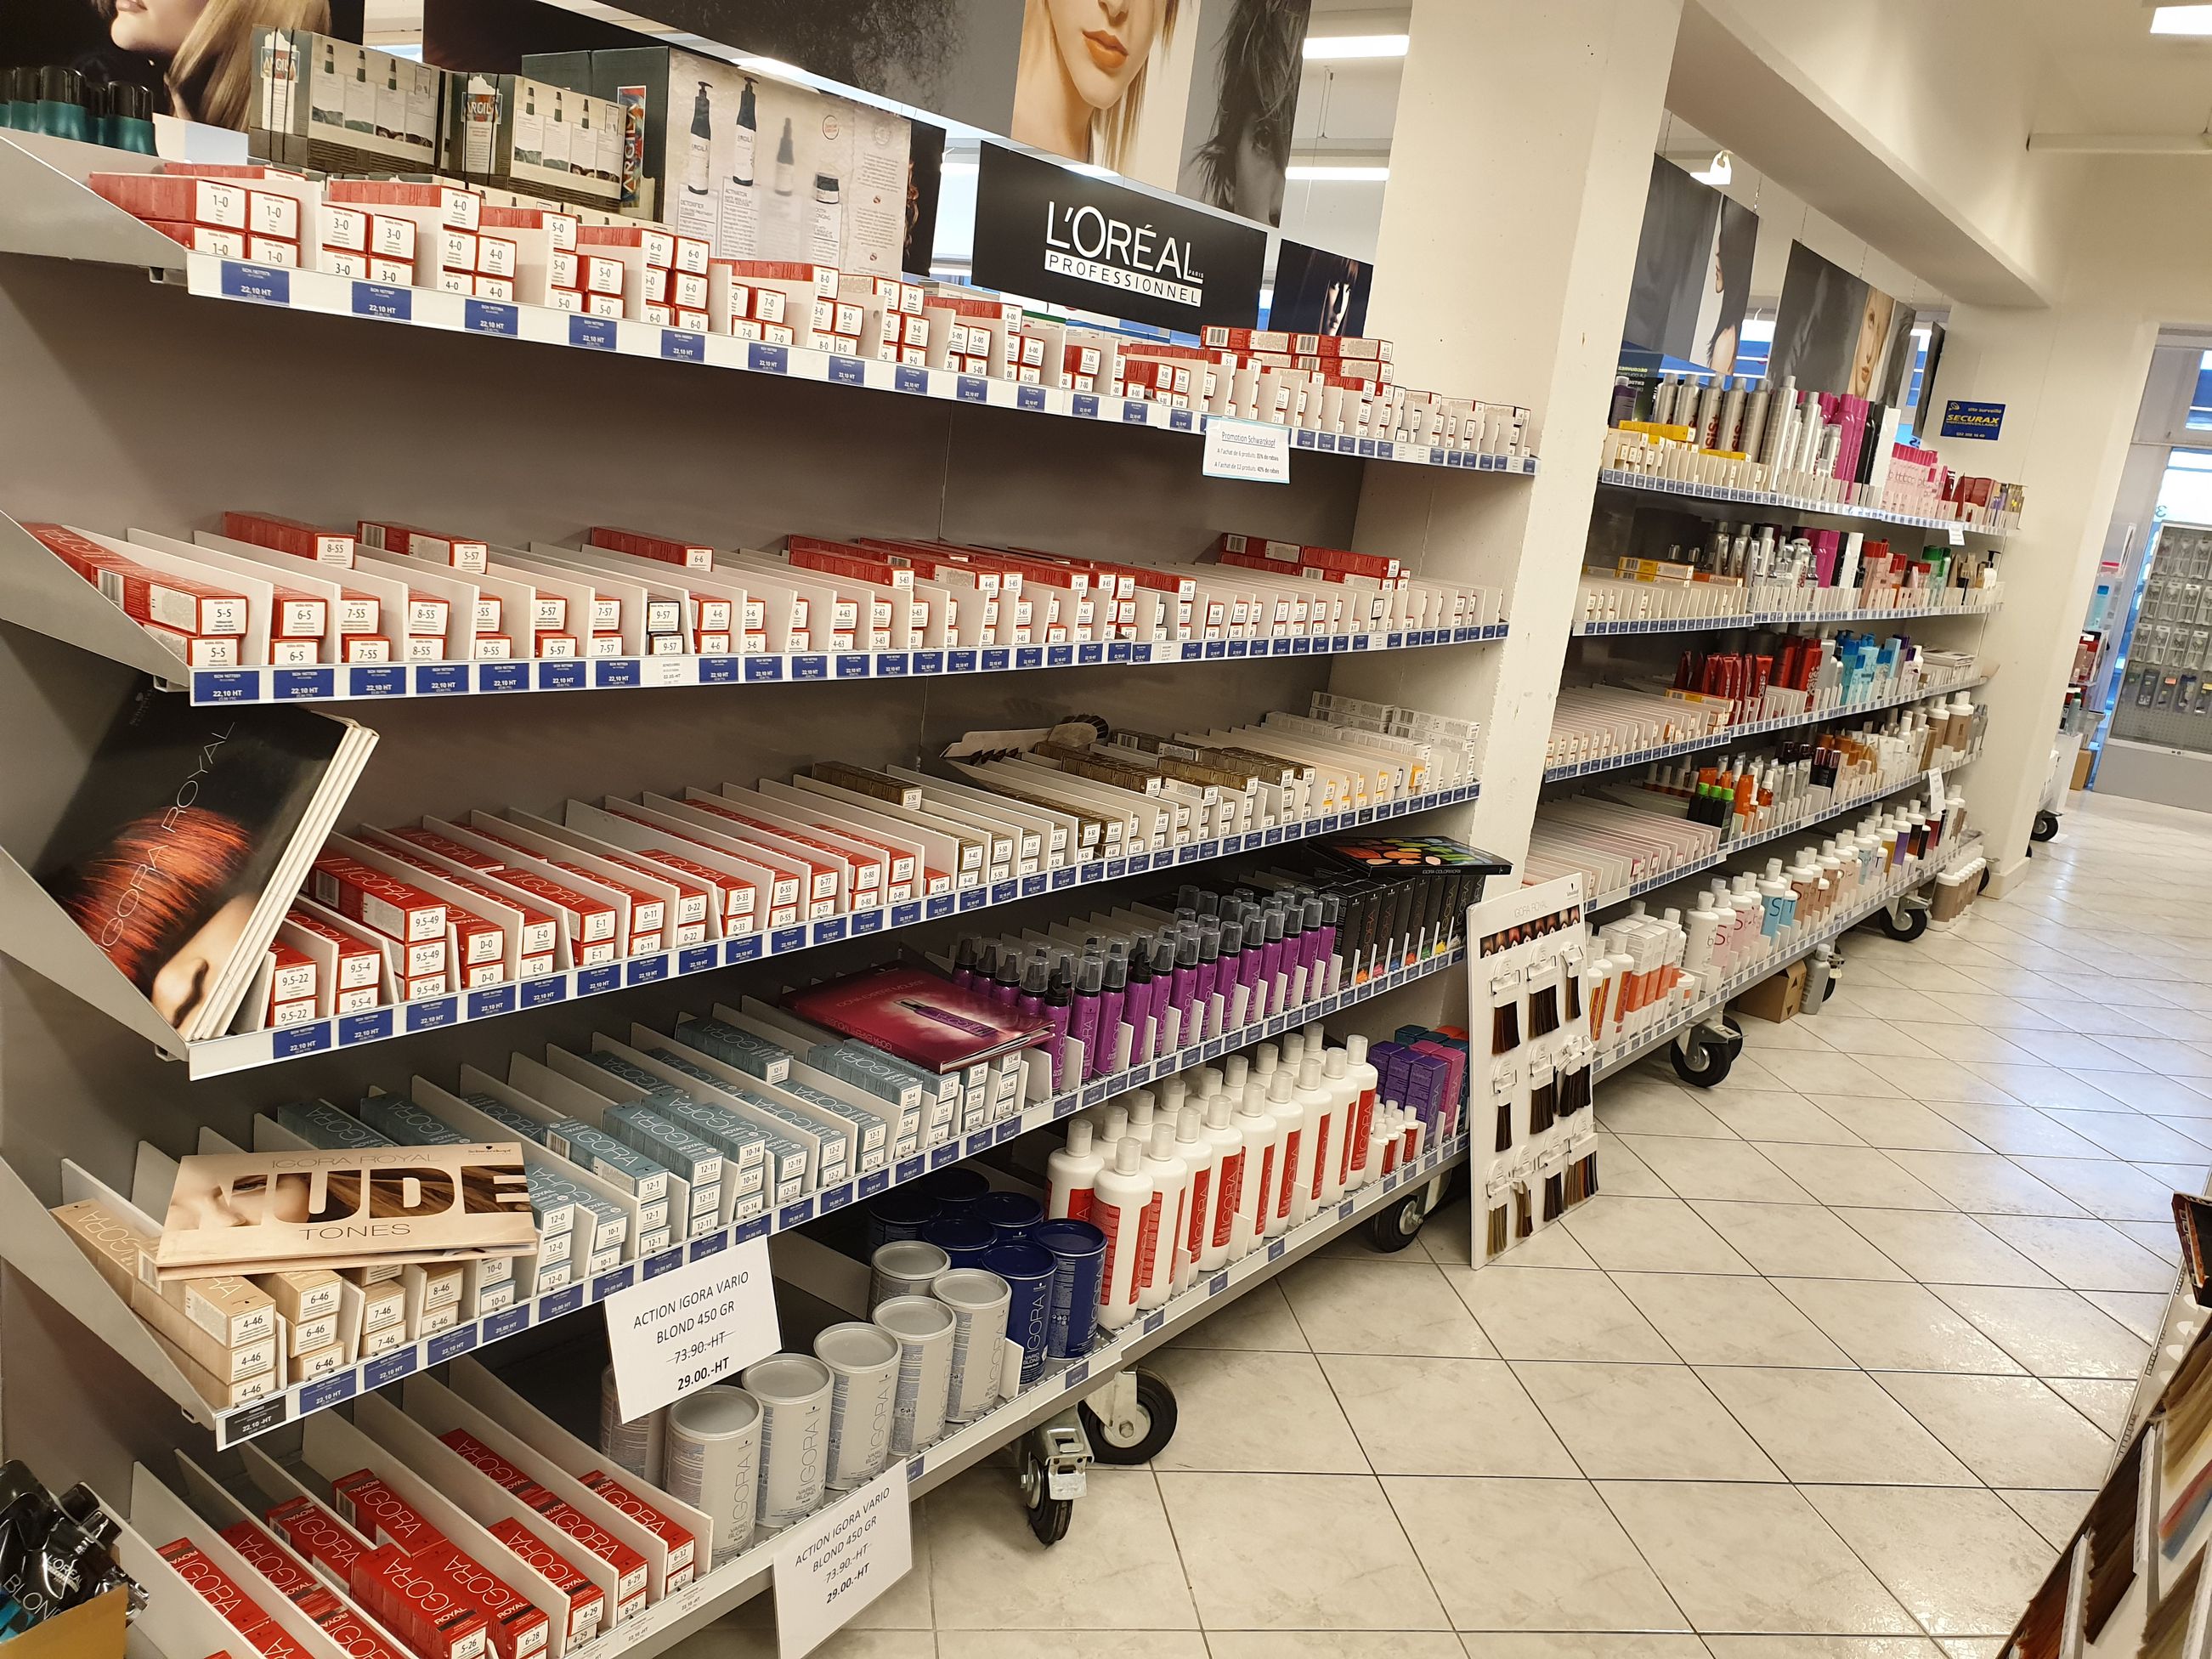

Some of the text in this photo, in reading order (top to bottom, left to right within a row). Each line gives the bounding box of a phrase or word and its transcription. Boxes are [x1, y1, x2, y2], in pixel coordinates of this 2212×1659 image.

[213, 195, 228, 207] 1-0
[454, 200, 467, 211] 4-0
[267, 205, 280, 218] 1-0
[334, 218, 348, 230] 3-0
[387, 229, 400, 240] 3-0
[651, 242, 661, 252] 6-0
[1046, 201, 1203, 284] L'ORÉAL
[490, 249, 502, 259] 4-0
[688, 249, 699, 258] 6-0
[600, 267, 611, 277] 5-0
[1188, 269, 1204, 278] PARIS
[1049, 255, 1198, 304] PROFESSIONNEL
[1946, 415, 2000, 423] SECURAX
[1222, 431, 1247, 441] Promotion
[326, 544, 343, 553] 8-55
[464, 552, 478, 560] 5-57
[217, 609, 231, 618] 5-5
[297, 610, 311, 620] 6-5
[348, 609, 365, 618] 7-55
[417, 609, 435, 619] 8-55
[540, 607, 556, 615] 5-57
[598, 608, 613, 616] 7-57
[484, 646, 499, 654] 9-55
[97, 722, 235, 953] IGORA ROYAL
[348, 870, 415, 901] IGORA
[521, 878, 586, 905] IGORA
[780, 886, 791, 894] 0-55
[737, 893, 749, 902] 0-33
[687, 903, 700, 911] 0-22
[644, 910, 657, 919] 0-11
[537, 930, 547, 938] E-0
[481, 940, 492, 949] D-0
[1083, 1020, 1095, 1061] IGORA
[833, 1049, 889, 1078] IGORA
[1446, 1079, 1459, 1115] IGORA
[1428, 1083, 1440, 1130] IGORA
[630, 1109, 687, 1147] IGORA
[1361, 1103, 1375, 1155] IGORA
[574, 1129, 642, 1168] IGORA
[272, 1154, 440, 1168] IGORA ROYAL
[701, 1162, 716, 1174] 12-11
[647, 1181, 659, 1190] 12-1
[1222, 1170, 1239, 1241] IGORA
[551, 1214, 565, 1224] 12-0
[299, 1224, 410, 1240] TONES
[608, 1226, 619, 1236] 10-1
[487, 1263, 502, 1273] 10-0
[433, 1283, 450, 1294] 8-46
[311, 1292, 329, 1303] 6-46
[634, 1271, 749, 1328] ACTION IGORA VARIO
[375, 1306, 392, 1317] 7-46
[243, 1315, 263, 1328] 4-46
[657, 1301, 734, 1344] BLOND 450 GR
[1027, 1294, 1045, 1354] IGORA
[674, 1332, 726, 1364] 73.90.-HT
[1023, 1356, 1039, 1365] BLOND
[677, 1357, 729, 1390] 29.00.-HT
[870, 1387, 889, 1453] IGORA
[801, 1418, 819, 1486] IGORA
[455, 1441, 516, 1486] IGORA
[733, 1453, 751, 1523] IGORA
[284, 1508, 315, 1522] ROYAL
[360, 1487, 421, 1537] IGORA
[602, 1486, 665, 1535] IGORA
[795, 1487, 890, 1566] ACTION IGORA VARIO
[298, 1515, 360, 1568] IGORA
[552, 1510, 619, 1560] IGORA
[812, 1516, 877, 1572] BLOND 450 GR
[508, 1531, 581, 1589] IGORA
[674, 1549, 687, 1560] 6-32
[235, 1535, 301, 1589] IGORA
[826, 1543, 868, 1583] 73.90.-HT
[444, 1554, 516, 1610] IGORA
[627, 1574, 641, 1587] 8-29
[674, 1574, 687, 1586] 6-32
[827, 1563, 869, 1604] 29.00.-HT
[178, 1559, 241, 1617] IGORA
[383, 1558, 450, 1616] IGORA
[496, 1601, 527, 1618] ROYAL
[583, 1607, 597, 1620] 4-29
[625, 1602, 638, 1614] 8-29
[320, 1612, 348, 1628] ROYAL
[434, 1605, 467, 1625] ROYAL
[525, 1632, 540, 1645] 6-28
[573, 1631, 587, 1644] 4-29
[461, 1639, 477, 1654] 5-26
